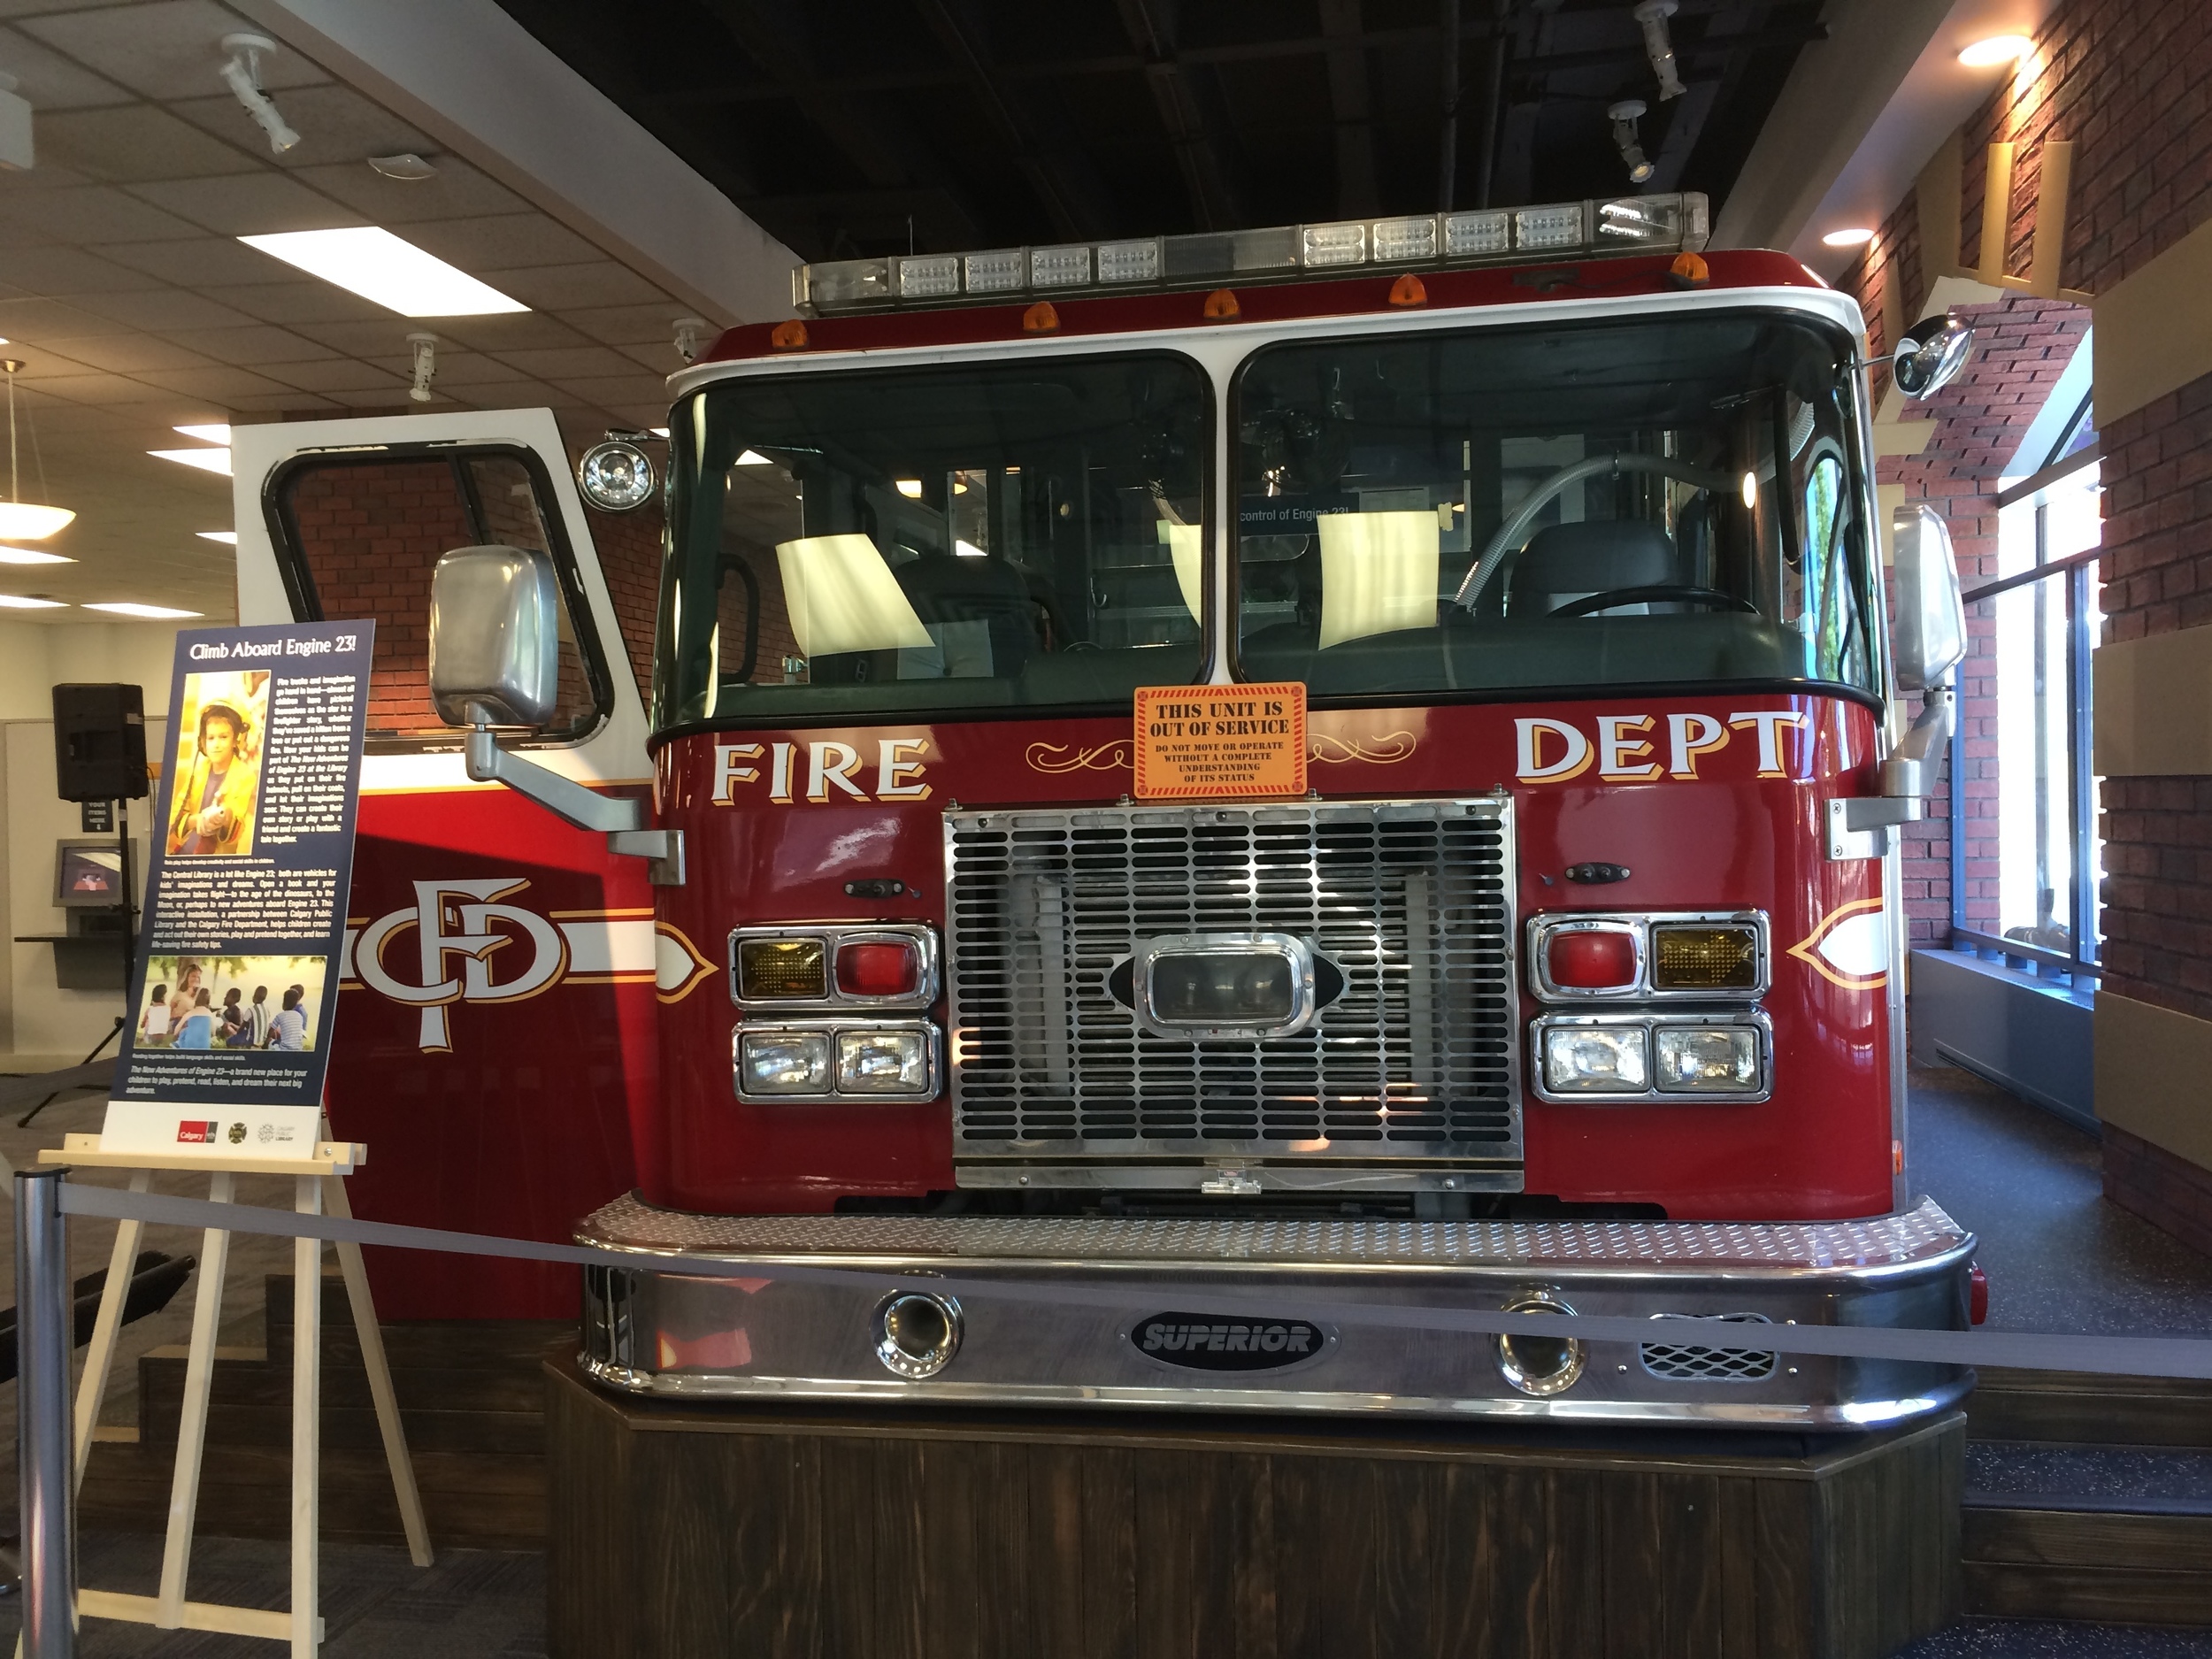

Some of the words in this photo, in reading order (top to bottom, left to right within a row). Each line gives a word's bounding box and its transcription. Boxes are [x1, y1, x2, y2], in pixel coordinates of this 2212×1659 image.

[1240, 510, 1276, 522] control
[1279, 509, 1290, 520] of
[189, 643, 229, 660] Climb
[231, 639, 282, 658] Aboard
[286, 637, 332, 657] Engine
[334, 634, 357, 652] 23!
[1156, 703, 1202, 718] THIS
[1210, 702, 1256, 718] UNIT
[1264, 701, 1283, 716] IS
[1150, 722, 1185, 737] OUT
[1189, 721, 1211, 736] OF
[1215, 719, 1289, 735] SERVICE
[1240, 741, 1284, 750] OPERATE
[710, 738, 933, 806] FIRE
[1515, 711, 1810, 784] DEPT
[1164, 754, 1210, 763] WITHOUT
[1222, 752, 1272, 761] COMPLETE
[1179, 764, 1260, 772] UNDERSTANDING
[180, 1131, 204, 1141] Calgary
[1142, 1323, 1311, 1352] SUPERIOR
